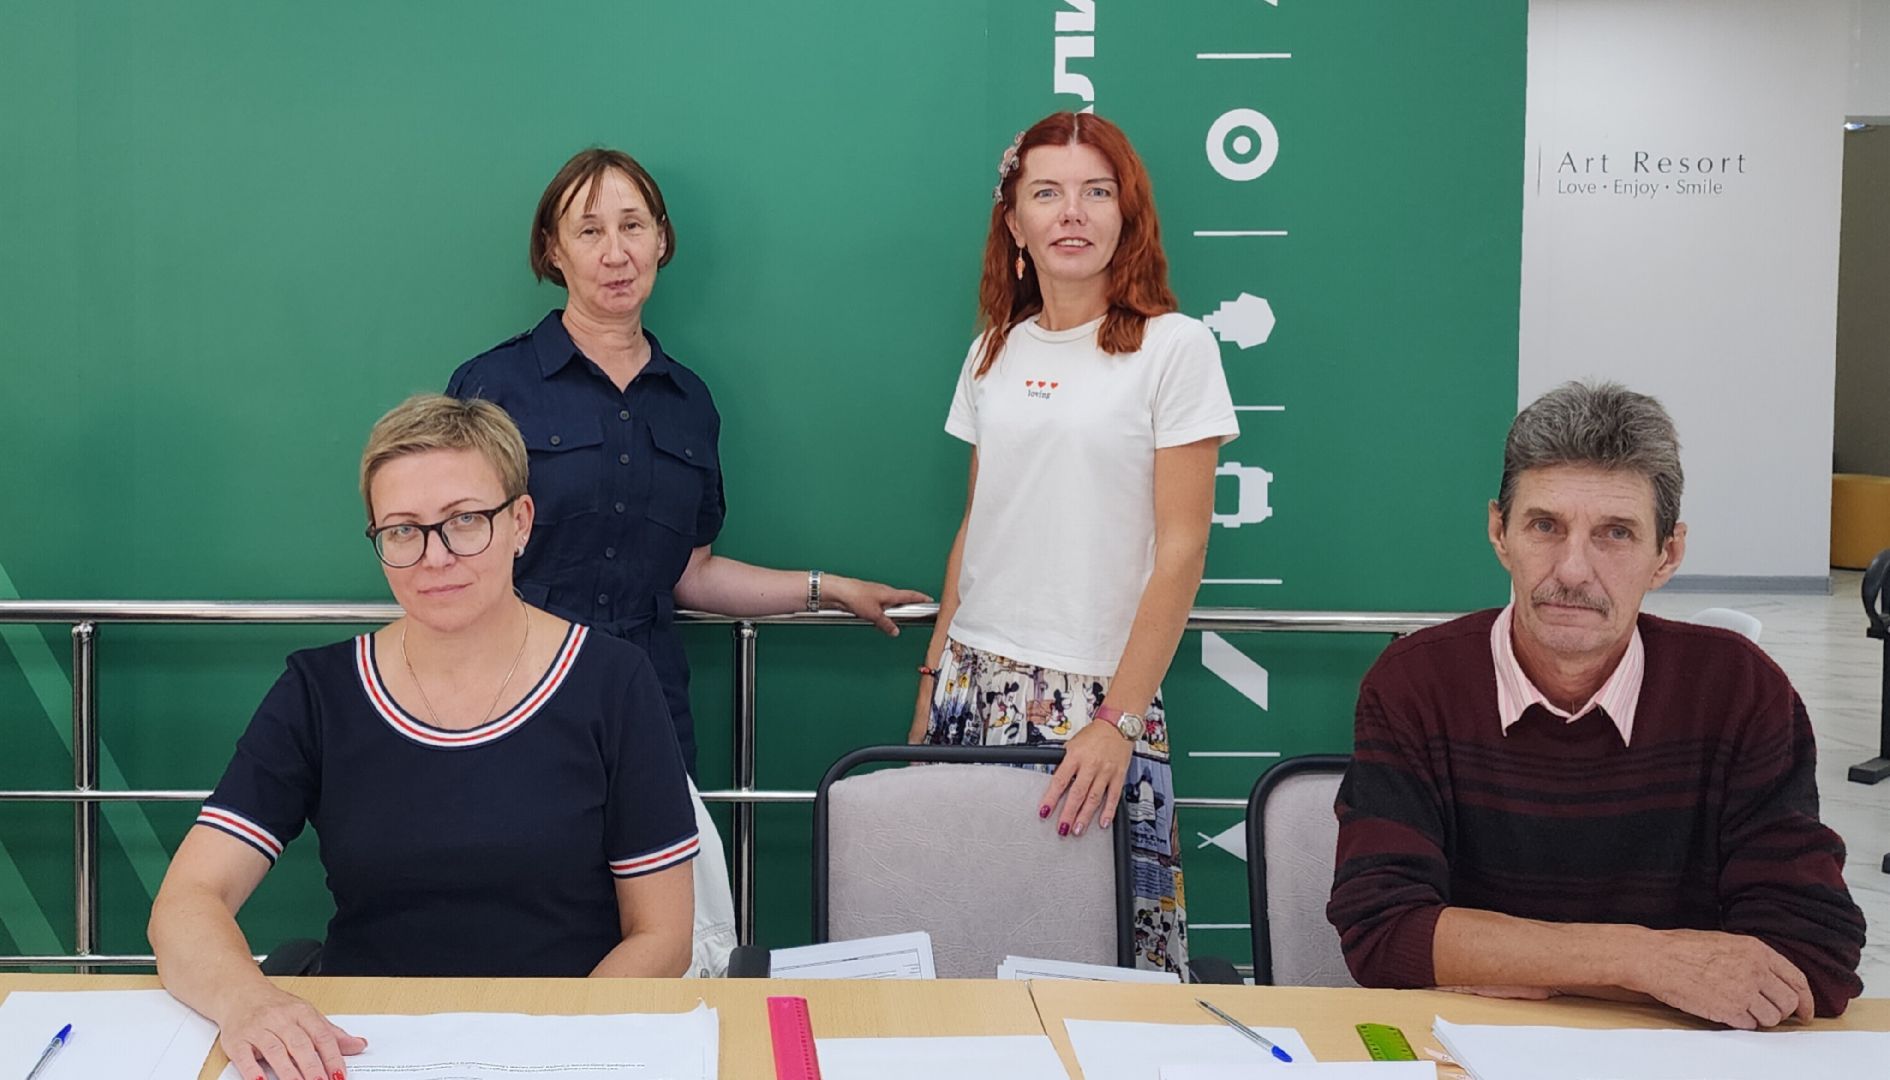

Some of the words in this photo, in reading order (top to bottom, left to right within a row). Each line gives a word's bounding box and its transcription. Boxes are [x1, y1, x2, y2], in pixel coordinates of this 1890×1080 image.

[1054, 0, 1095, 114] ЛИ
[1557, 151, 1608, 173] Art
[1634, 151, 1746, 173] Resort
[1558, 179, 1597, 194] Love
[1614, 179, 1660, 199] Enjoy
[1676, 179, 1723, 194] Smile
